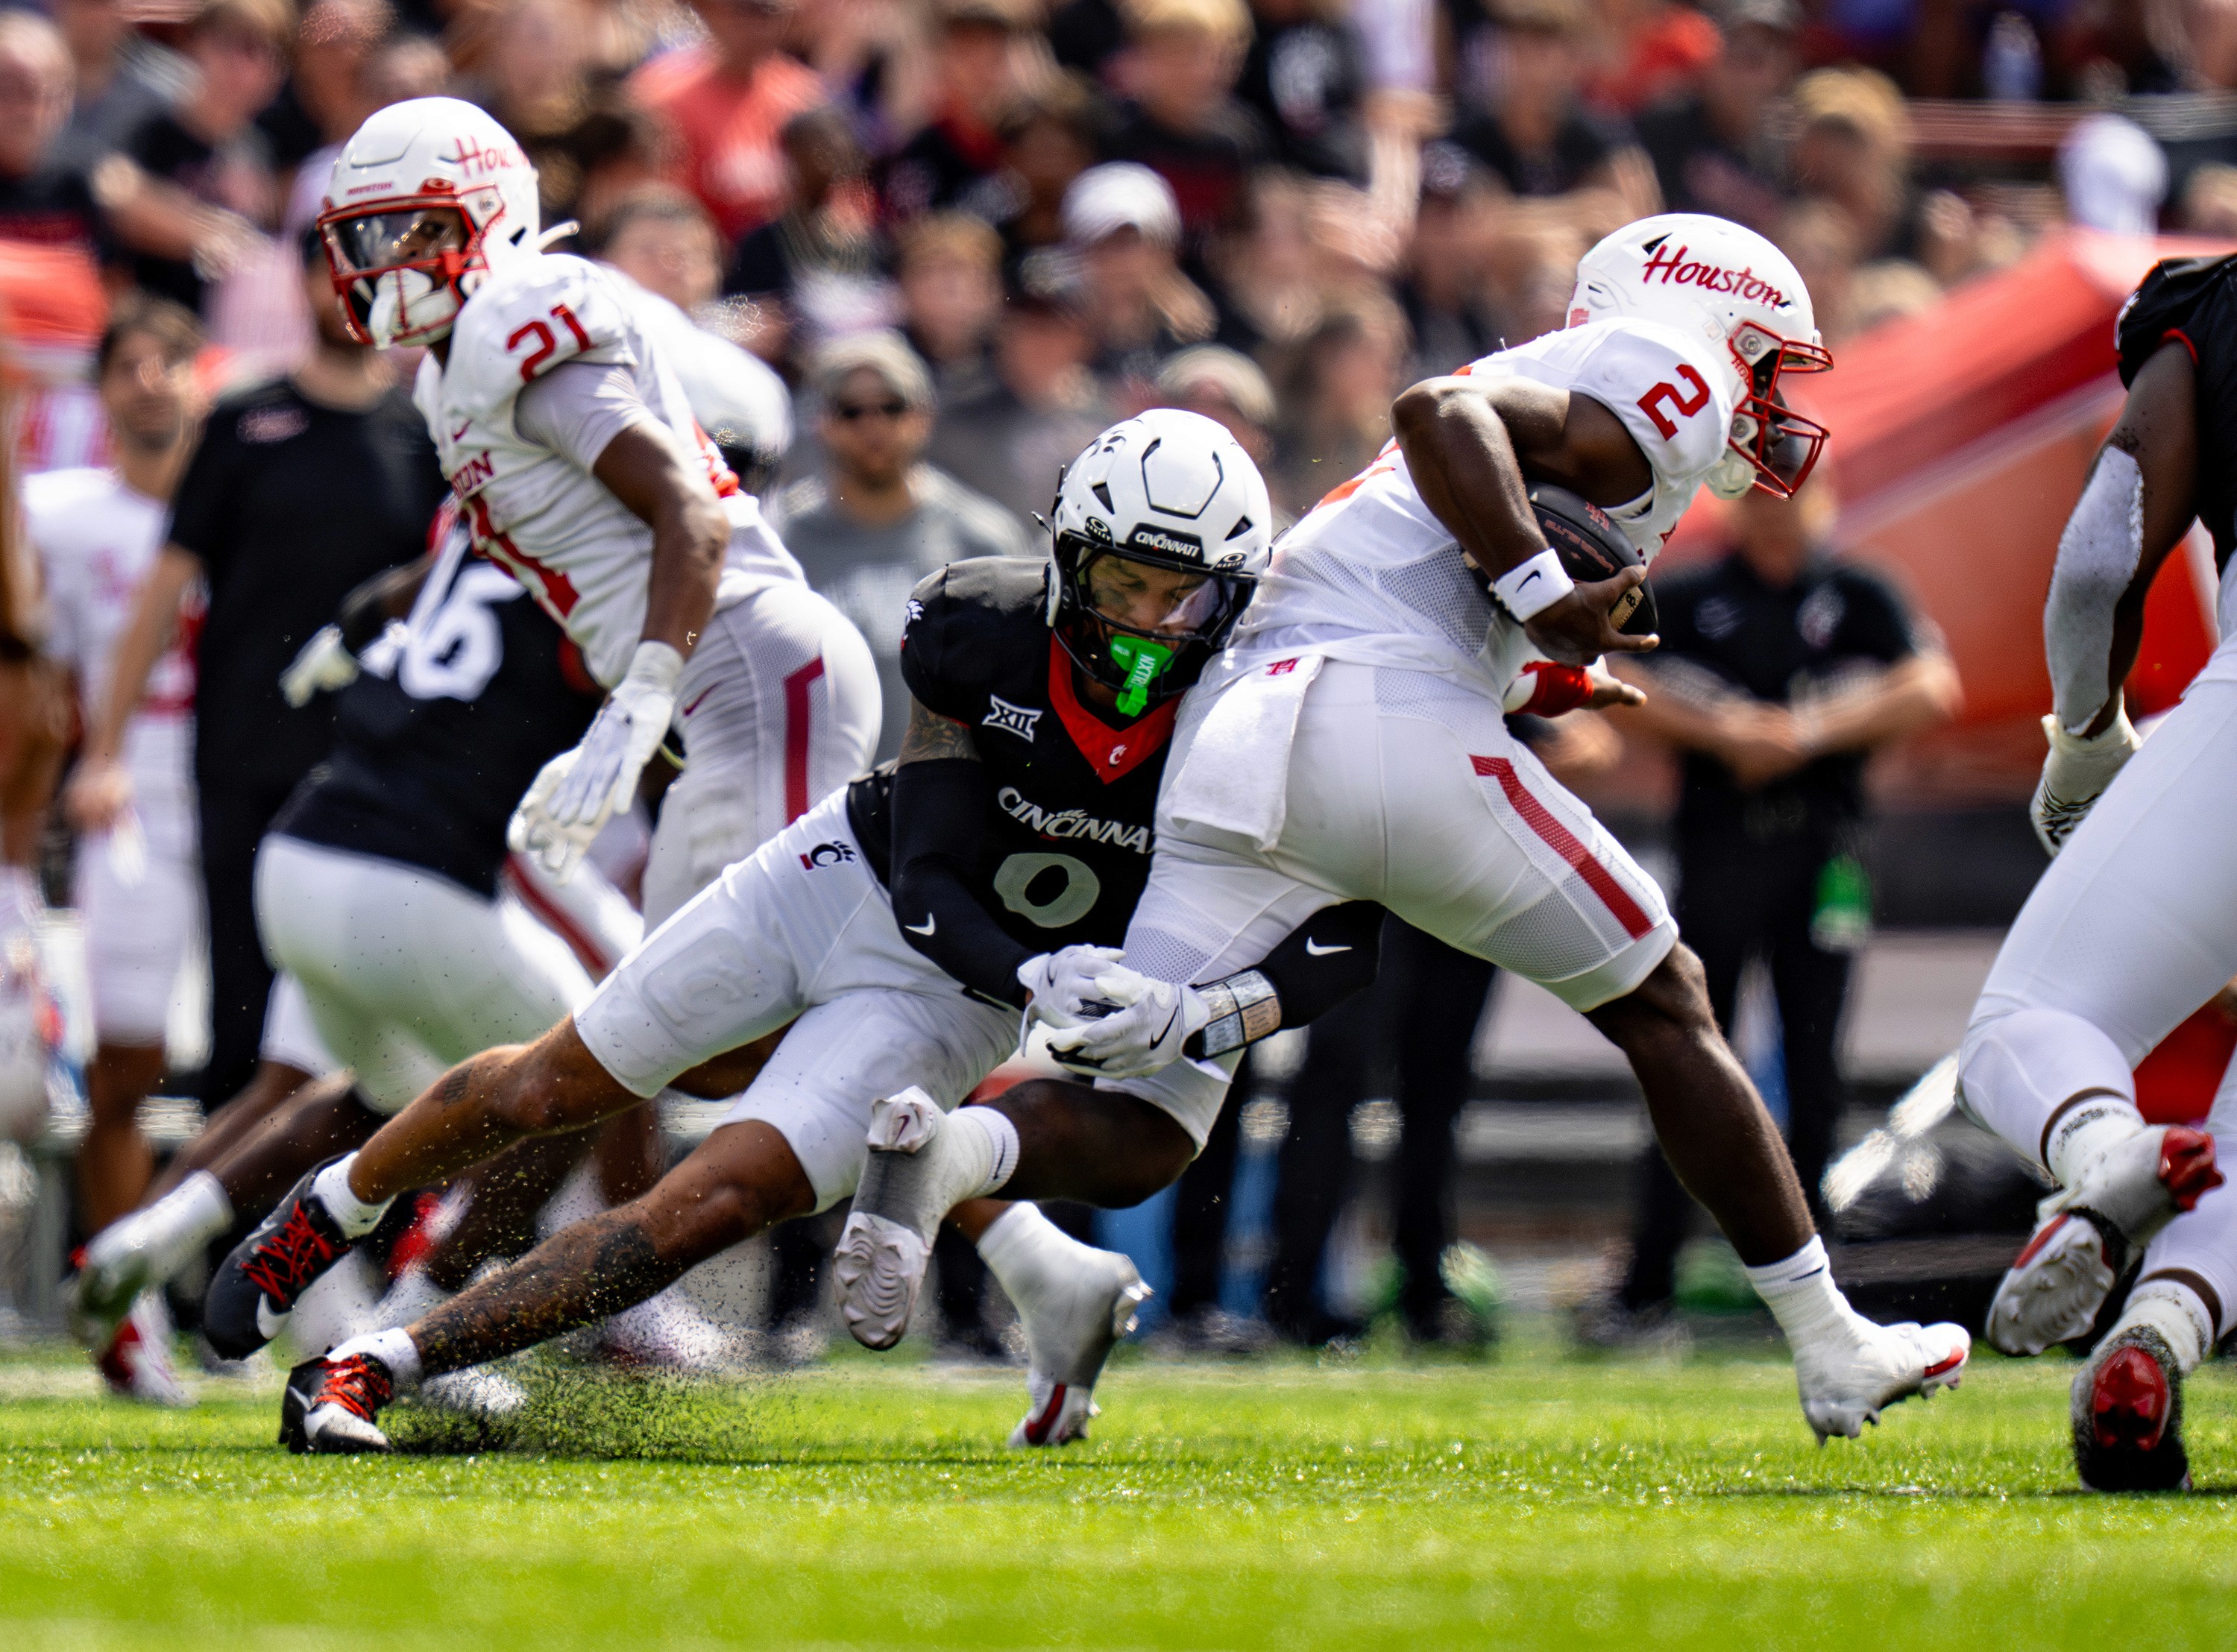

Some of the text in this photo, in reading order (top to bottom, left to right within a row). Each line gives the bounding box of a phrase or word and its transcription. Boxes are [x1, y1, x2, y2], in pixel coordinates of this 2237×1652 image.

[1643, 243, 1783, 310] Houston
[506, 303, 594, 384] 21
[1637, 363, 1710, 441] 2
[1086, 523, 1111, 542] OAKLEY
[1134, 531, 1200, 558] CINCINNATI
[998, 786, 1156, 854] CINCINNA
[993, 852, 1101, 929] 0
